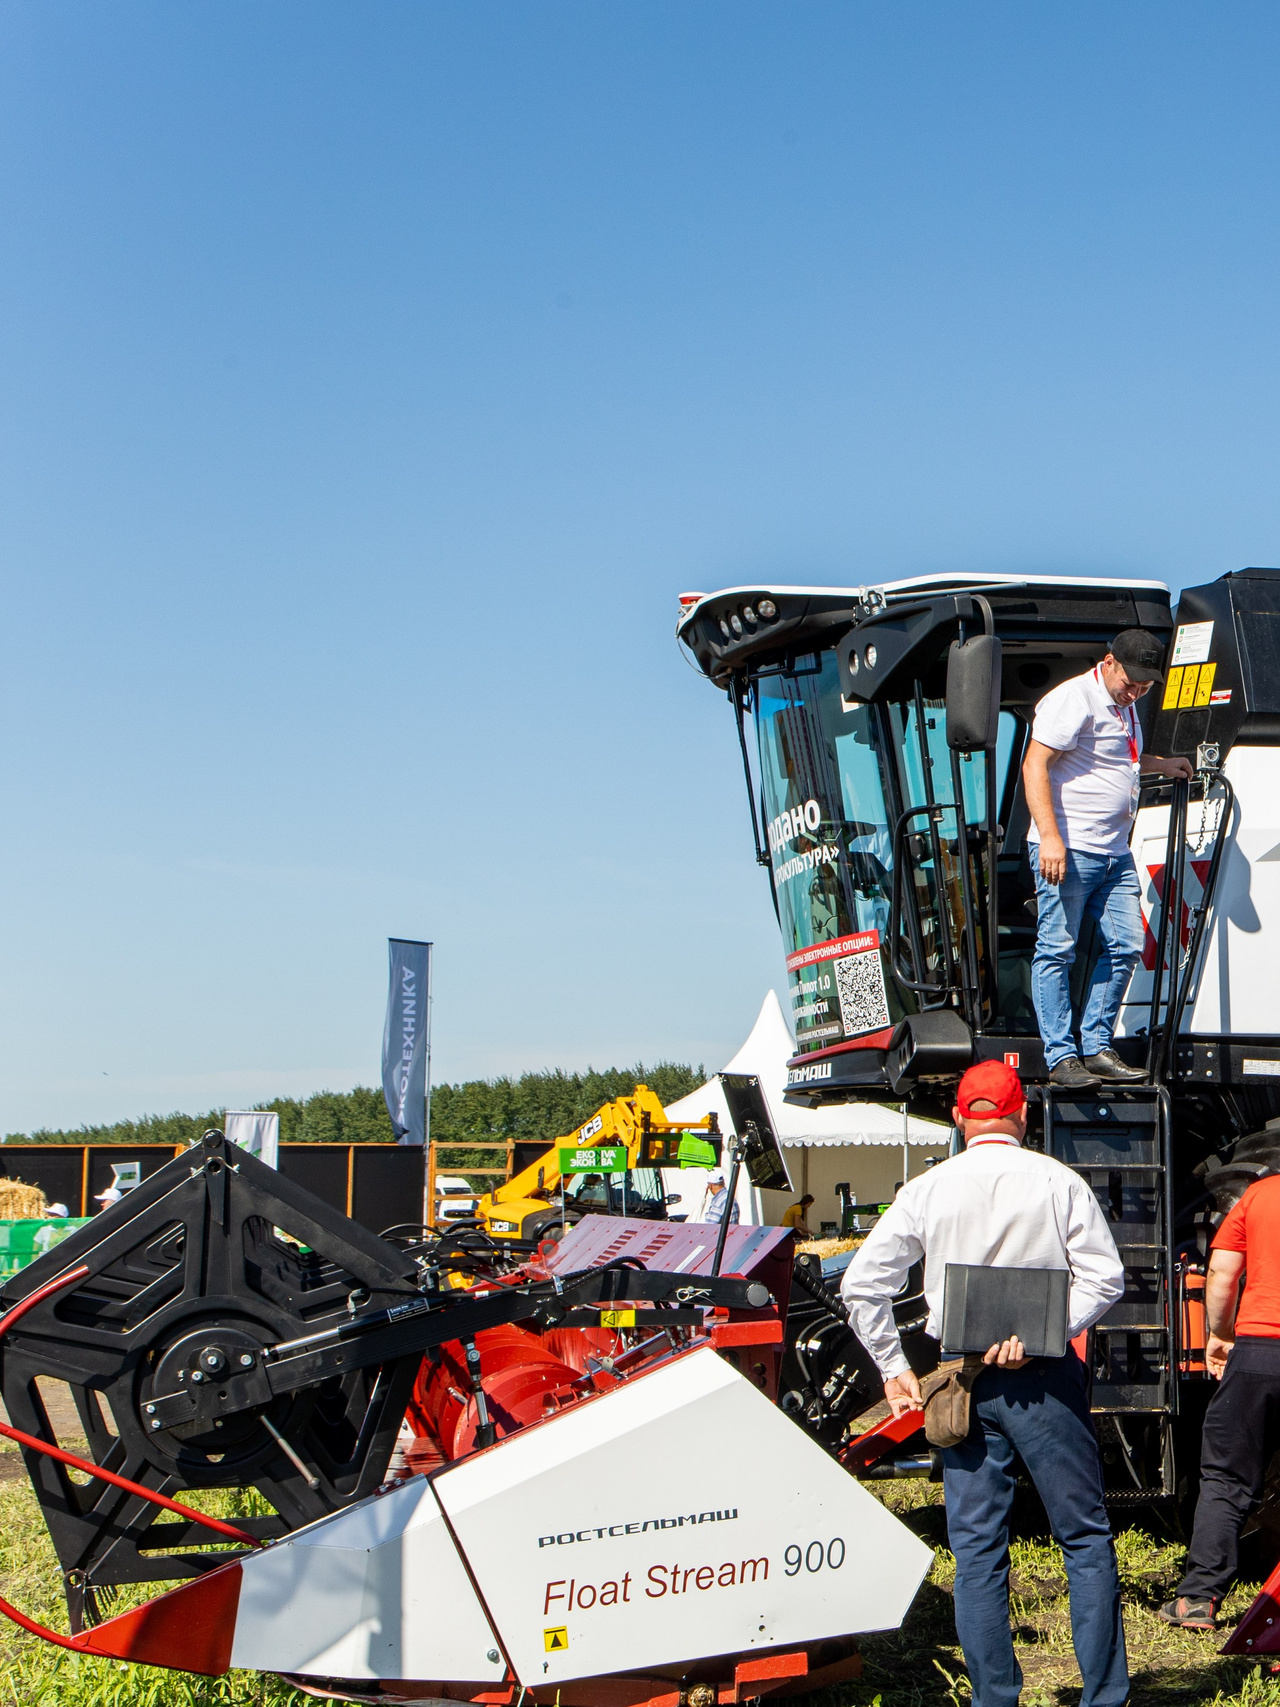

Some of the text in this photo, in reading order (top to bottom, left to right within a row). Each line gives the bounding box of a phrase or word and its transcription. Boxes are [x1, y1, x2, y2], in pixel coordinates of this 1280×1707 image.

[803, 943, 842, 963] ЭЛЕКТРОННЫЕ
[842, 936, 874, 952] ОПЦИИ:
[818, 975, 831, 991] 1.0
[577, 1115, 603, 1145] JCB
[491, 1221, 509, 1232] JCB
[537, 1508, 739, 1548] РОСТСЕЛЬМАШ
[543, 1537, 846, 1616] Float Stream 900
